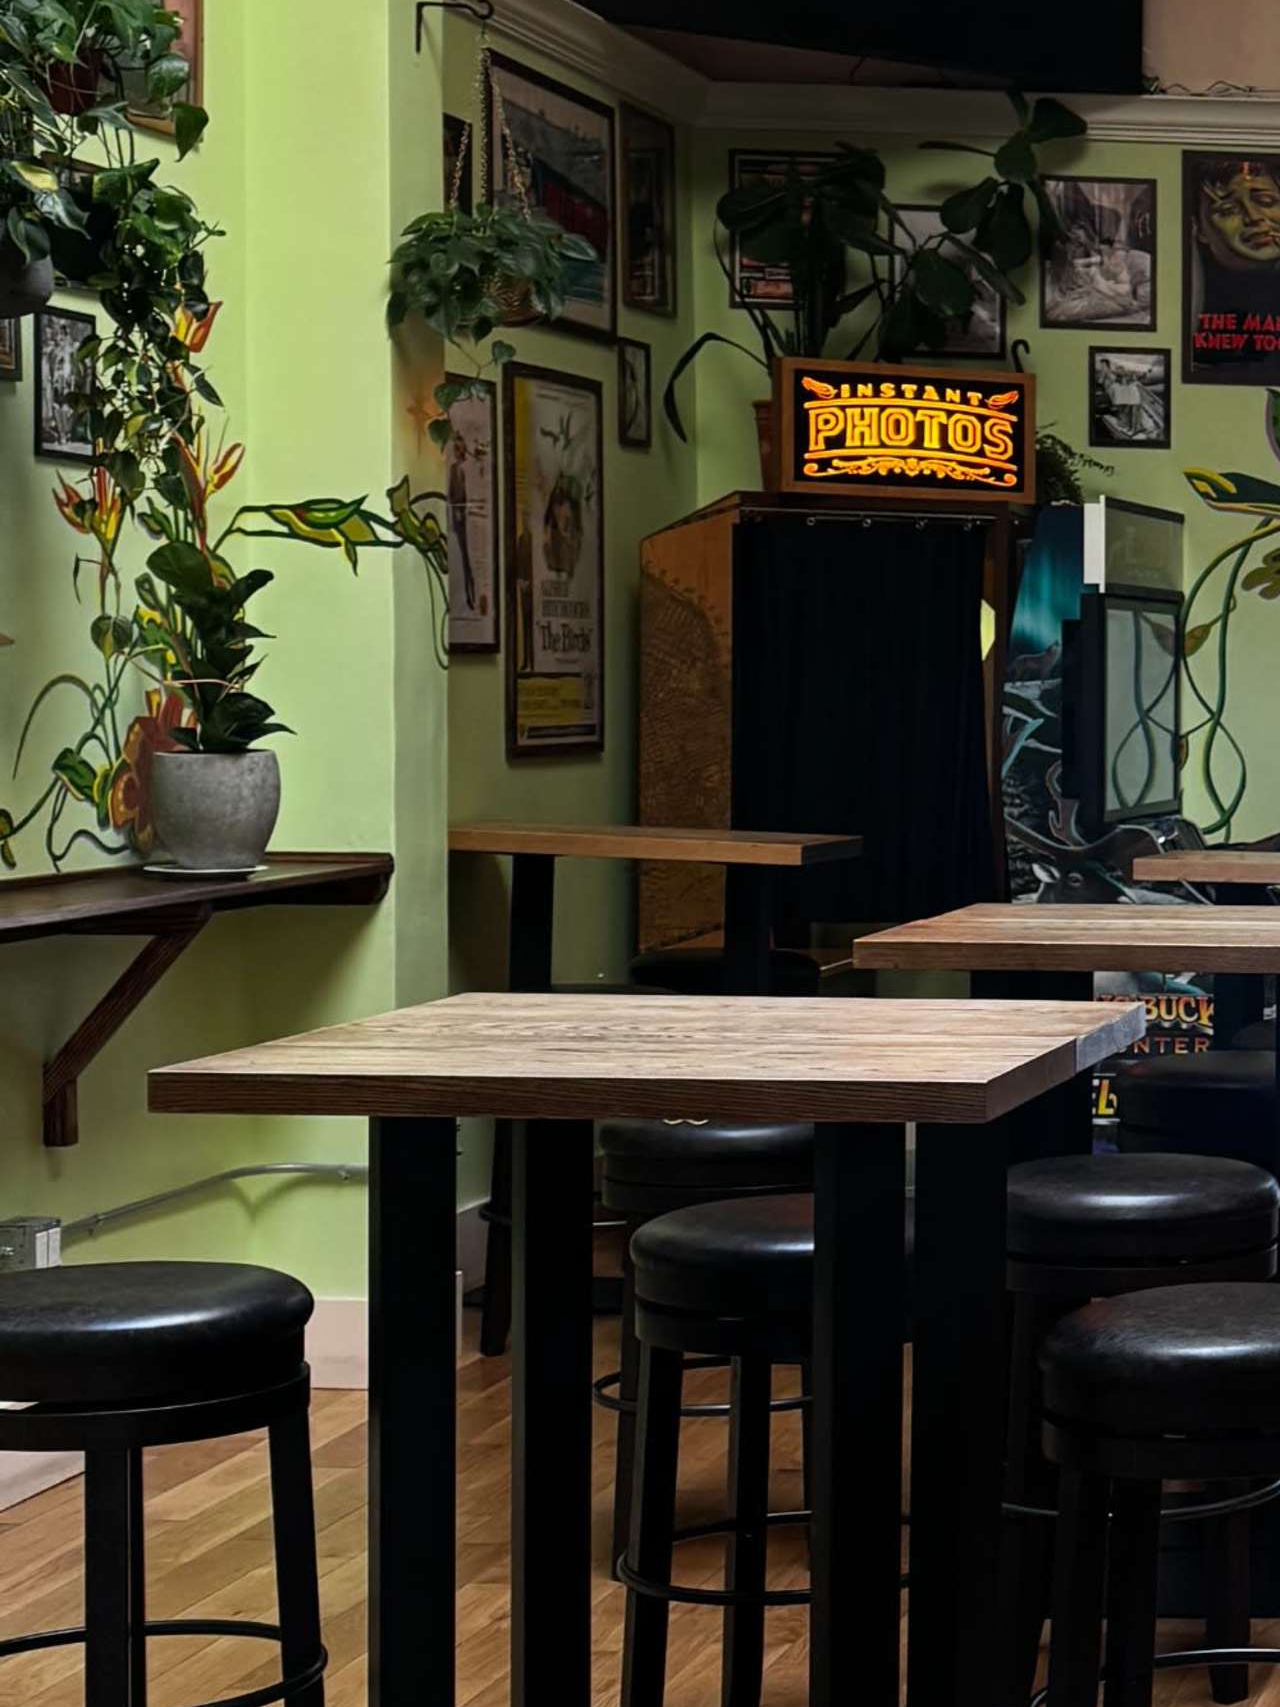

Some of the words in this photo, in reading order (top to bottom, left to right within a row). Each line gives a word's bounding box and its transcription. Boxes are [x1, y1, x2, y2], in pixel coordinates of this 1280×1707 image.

[1198, 313, 1237, 330] THE
[1193, 332, 1249, 350] KNEW
[840, 382, 983, 406] INSTANT
[808, 406, 1014, 461] PHOTOS
[1119, 1036, 1210, 1054] NTER
